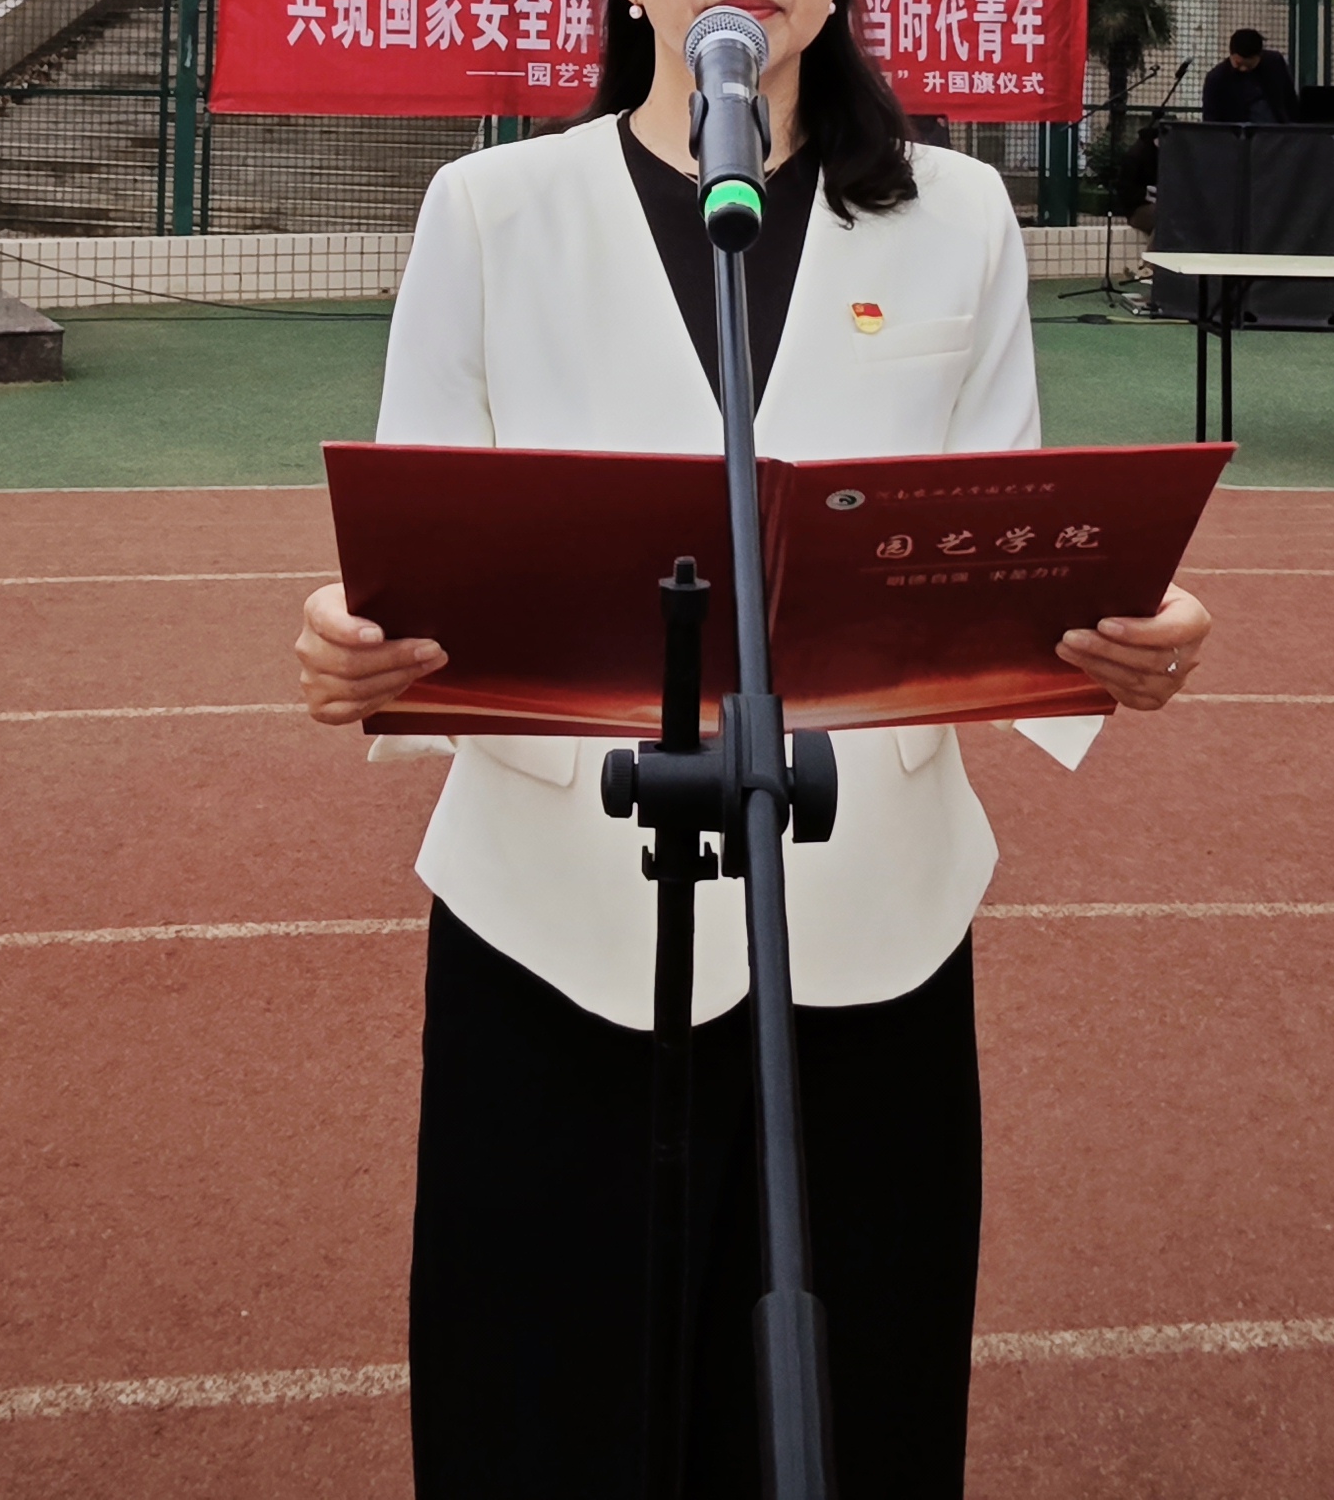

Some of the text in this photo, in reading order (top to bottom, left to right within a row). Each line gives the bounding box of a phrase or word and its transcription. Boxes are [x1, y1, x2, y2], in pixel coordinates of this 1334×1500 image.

[881, 69, 1045, 96] ”升国旗仪式
[876, 524, 1101, 559] 园艺学院
